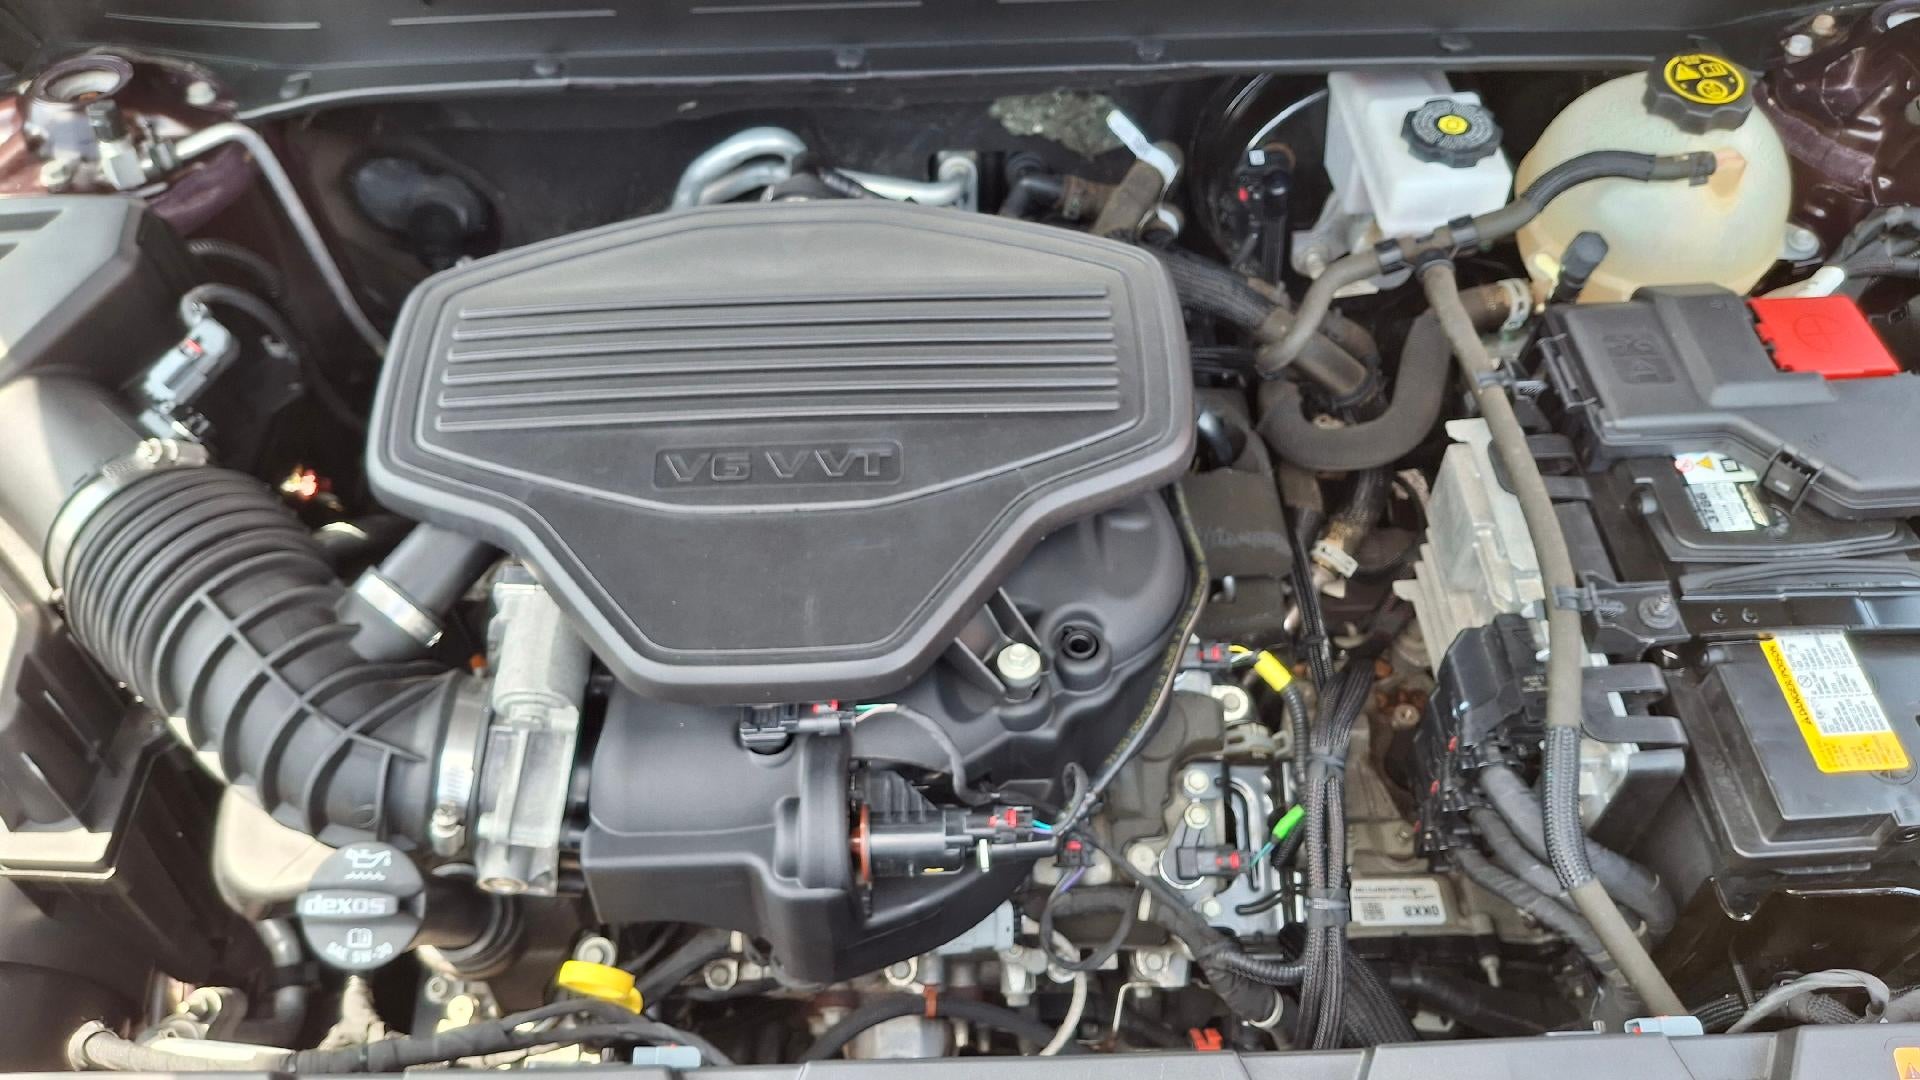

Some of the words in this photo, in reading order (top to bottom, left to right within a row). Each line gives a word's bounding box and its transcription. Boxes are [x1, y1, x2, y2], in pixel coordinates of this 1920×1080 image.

[664, 450, 752, 482] V6
[765, 447, 894, 479] VVT
[304, 894, 386, 916] dexos
